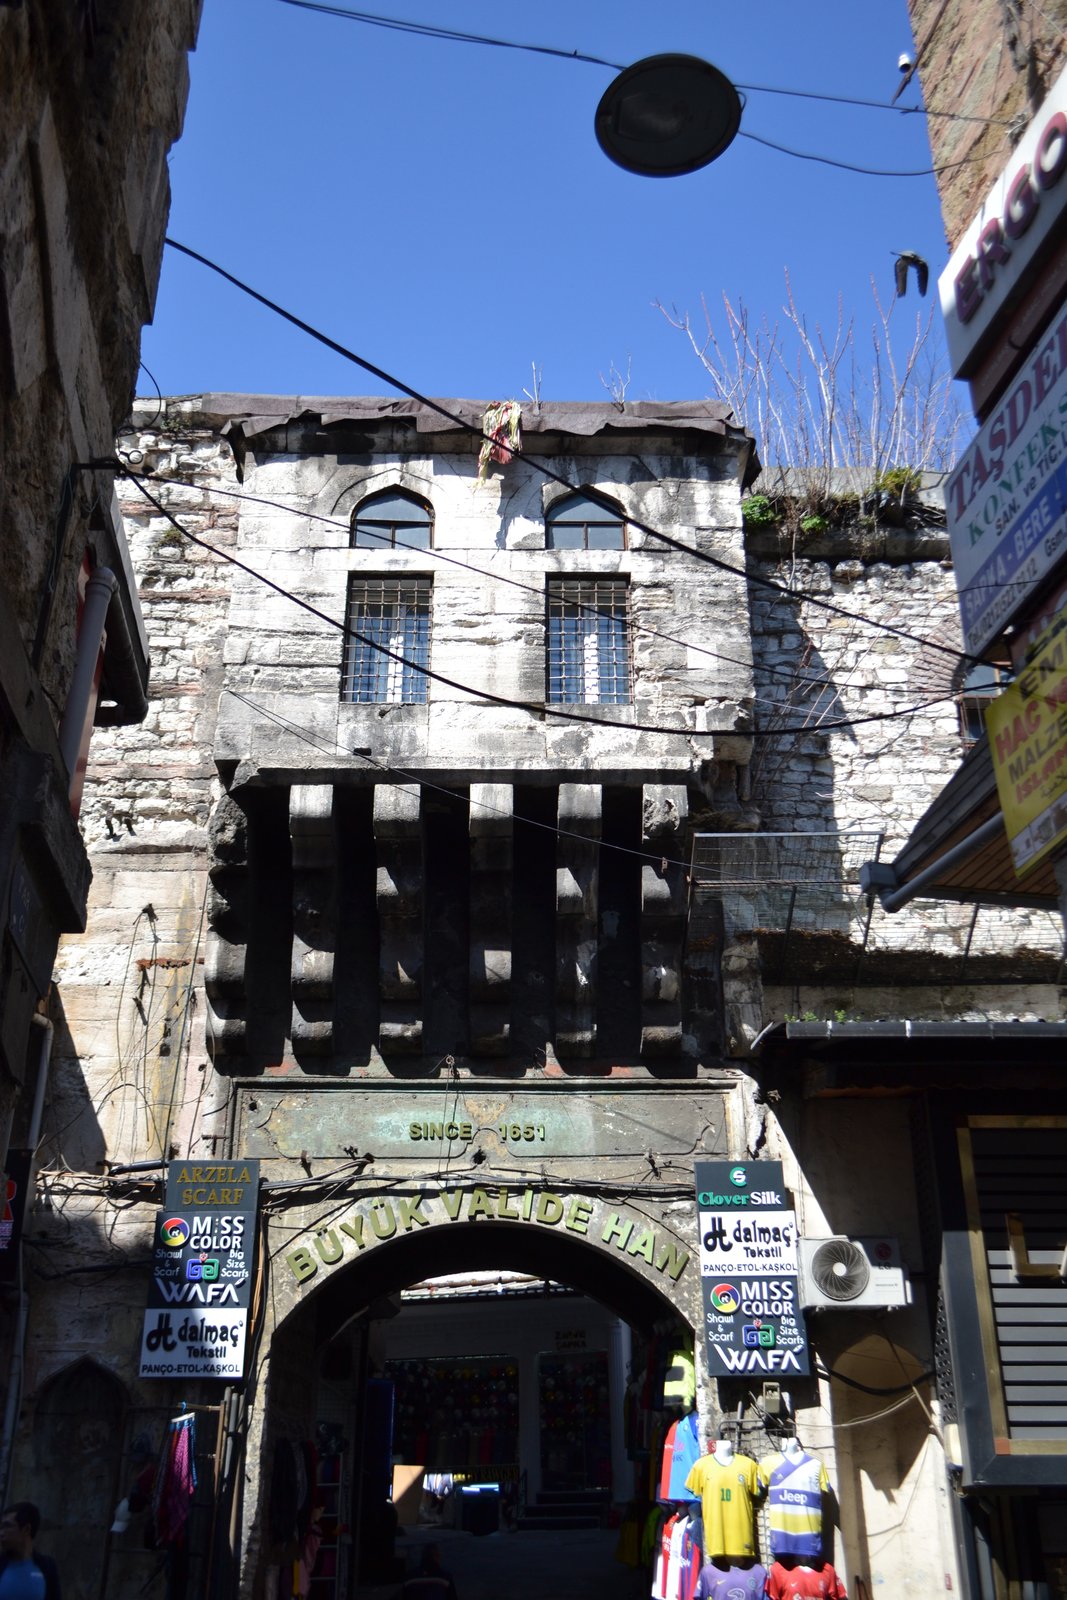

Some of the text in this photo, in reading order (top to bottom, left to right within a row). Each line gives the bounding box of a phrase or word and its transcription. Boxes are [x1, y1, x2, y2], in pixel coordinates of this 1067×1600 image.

[1014, 496, 1052, 560] BERE
[995, 700, 1042, 766] HAC
[409, 1121, 545, 1141] SINCE 1651
[177, 1166, 251, 1184] ARZELA
[182, 1188, 244, 1206] SCARF
[286, 1193, 430, 1284] BÜYÜK
[601, 1212, 690, 1281] HAN
[733, 1219, 791, 1248] dalmaç
[190, 1235, 242, 1250] COLOR
[155, 1248, 183, 1259] Shawl
[229, 1248, 244, 1260] Big
[743, 1246, 782, 1258] Tekstil
[154, 1266, 180, 1277] Scarf
[226, 1259, 245, 1269] Size
[221, 1267, 249, 1278] Scarfs
[741, 1281, 794, 1300] MISS
[741, 1301, 794, 1316] COLOR
[707, 1313, 734, 1323] Shawl
[781, 1315, 796, 1326] Big
[178, 1316, 239, 1348] dalmaç
[708, 1331, 734, 1342] Scarf
[779, 1326, 799, 1336] Size
[776, 1335, 805, 1345] Scarfs
[187, 1346, 227, 1359] Tekstil
[720, 1487, 732, 1502] 10
[779, 1490, 808, 1505] Jeep
